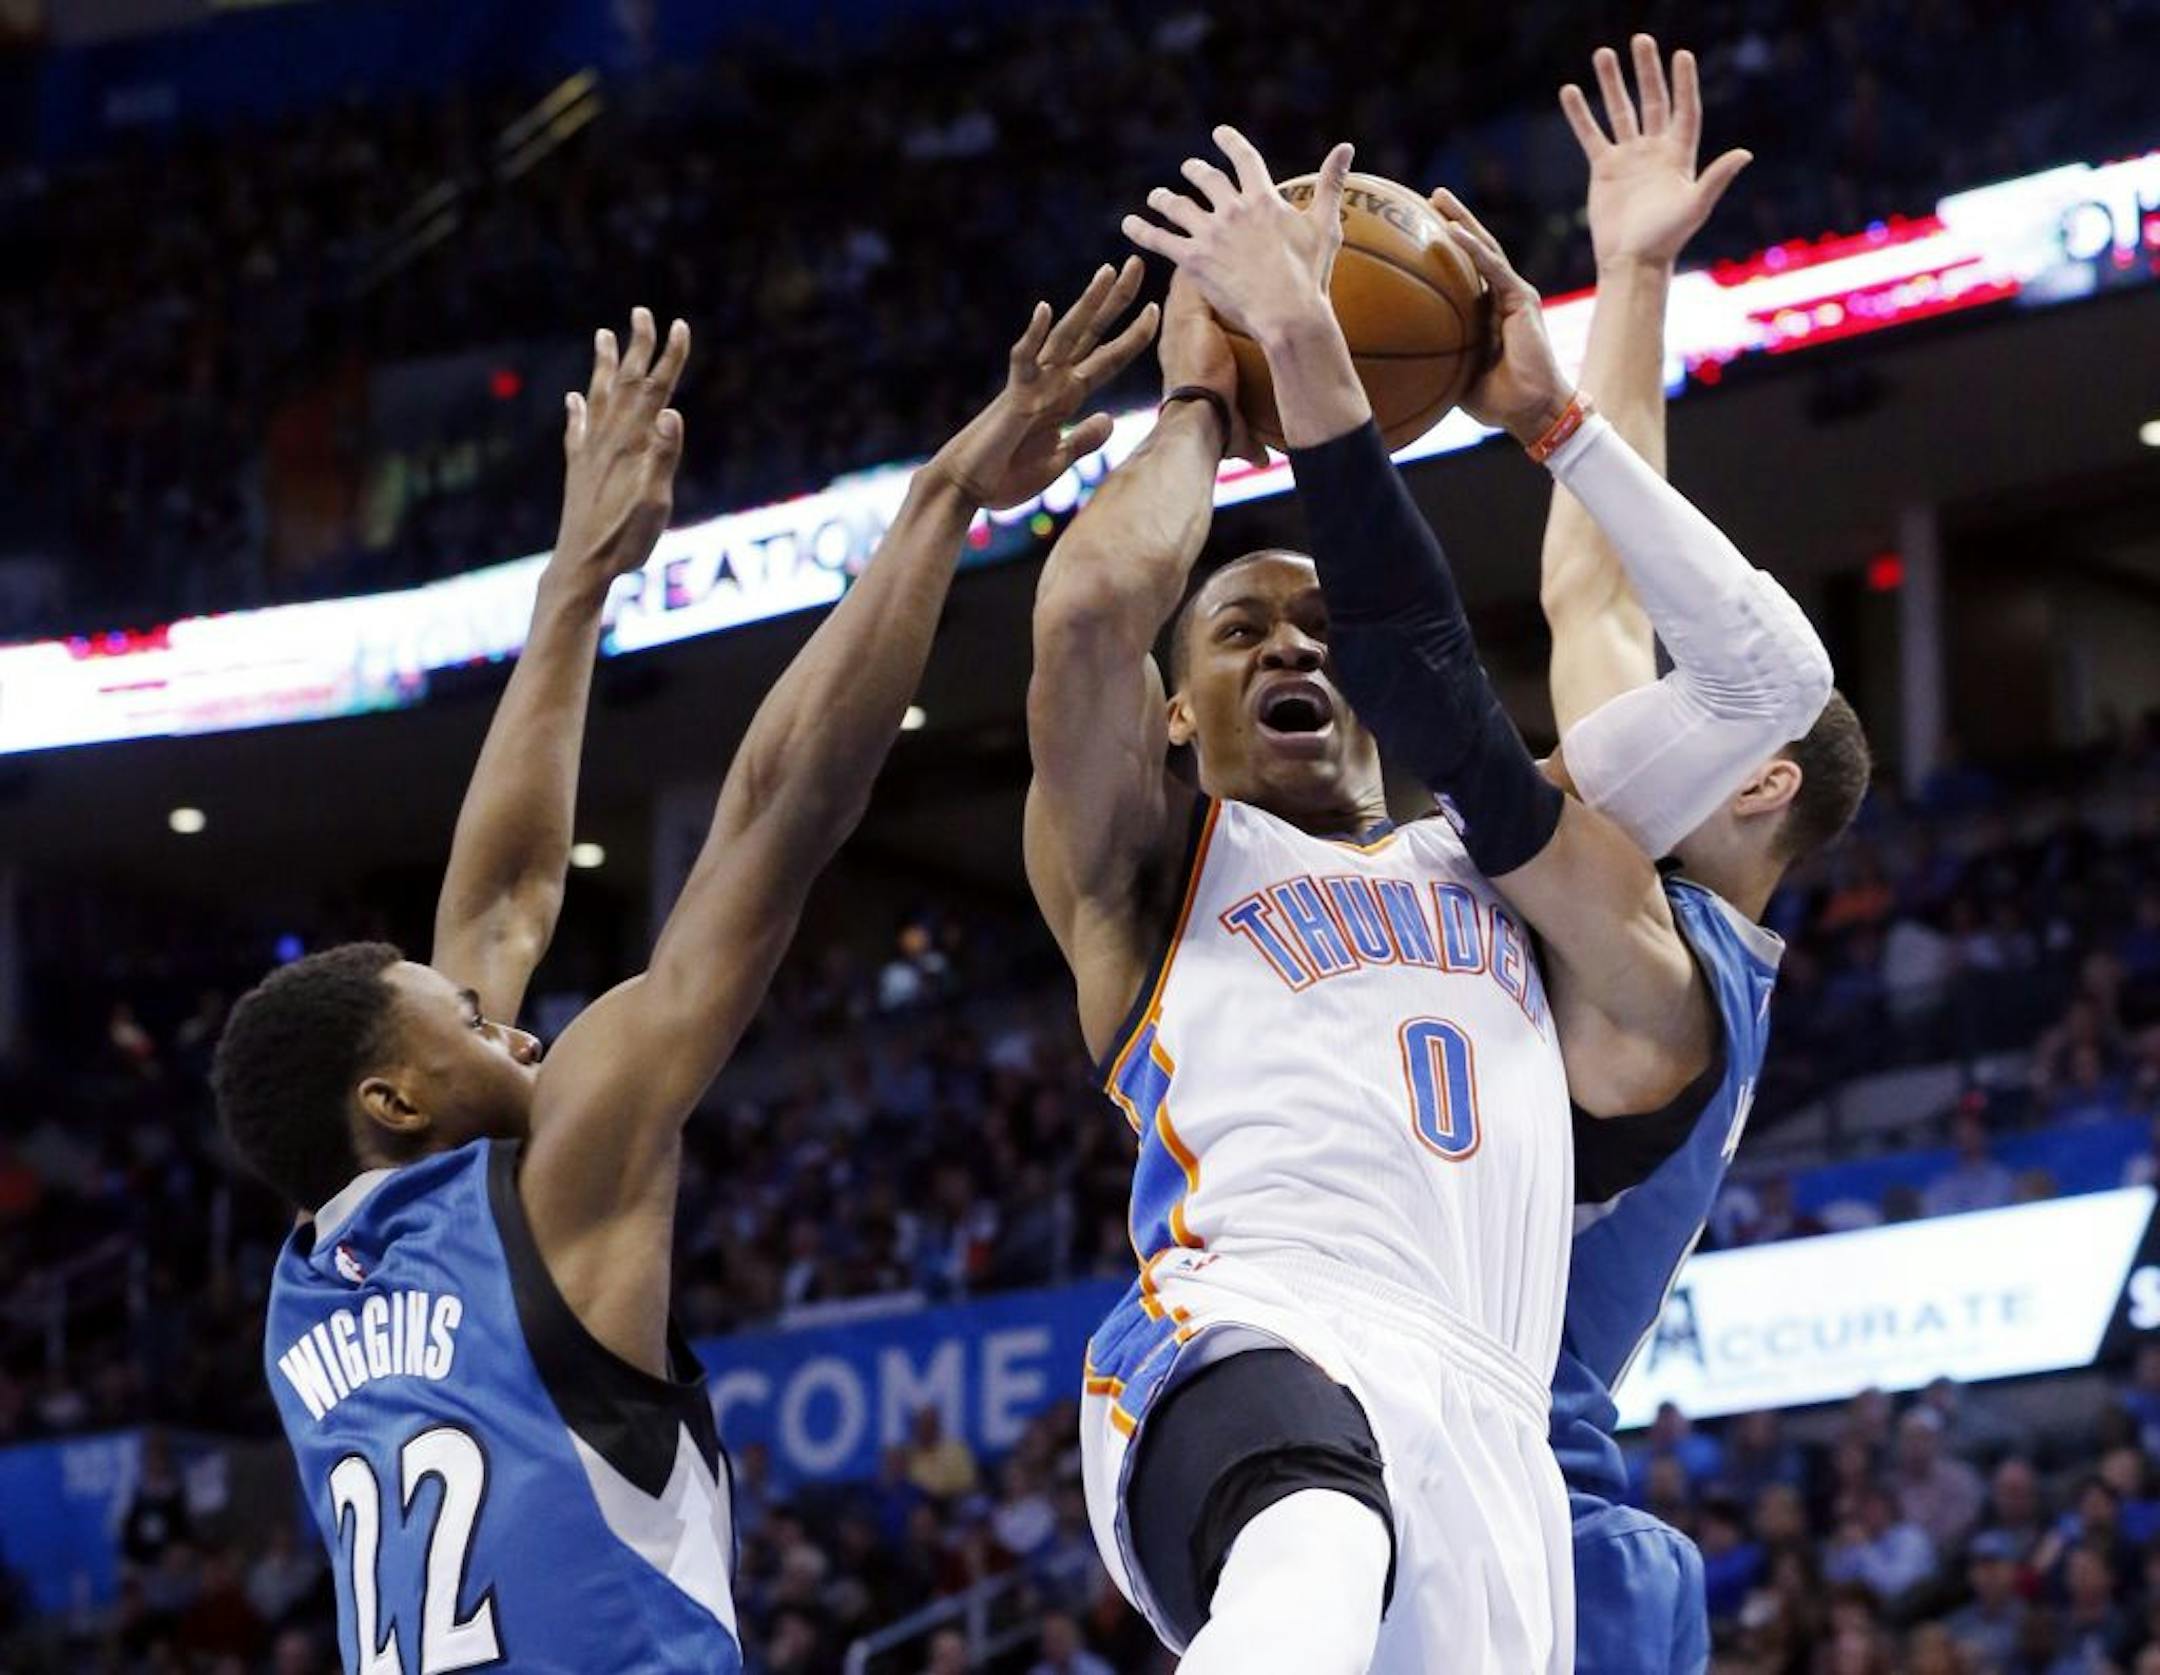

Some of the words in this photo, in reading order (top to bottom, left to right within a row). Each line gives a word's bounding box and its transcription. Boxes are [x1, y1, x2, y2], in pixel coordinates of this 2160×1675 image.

[1398, 1016, 1481, 1163] 0
[277, 1289, 463, 1423] WIGGINS
[328, 1420, 508, 1675] 22
